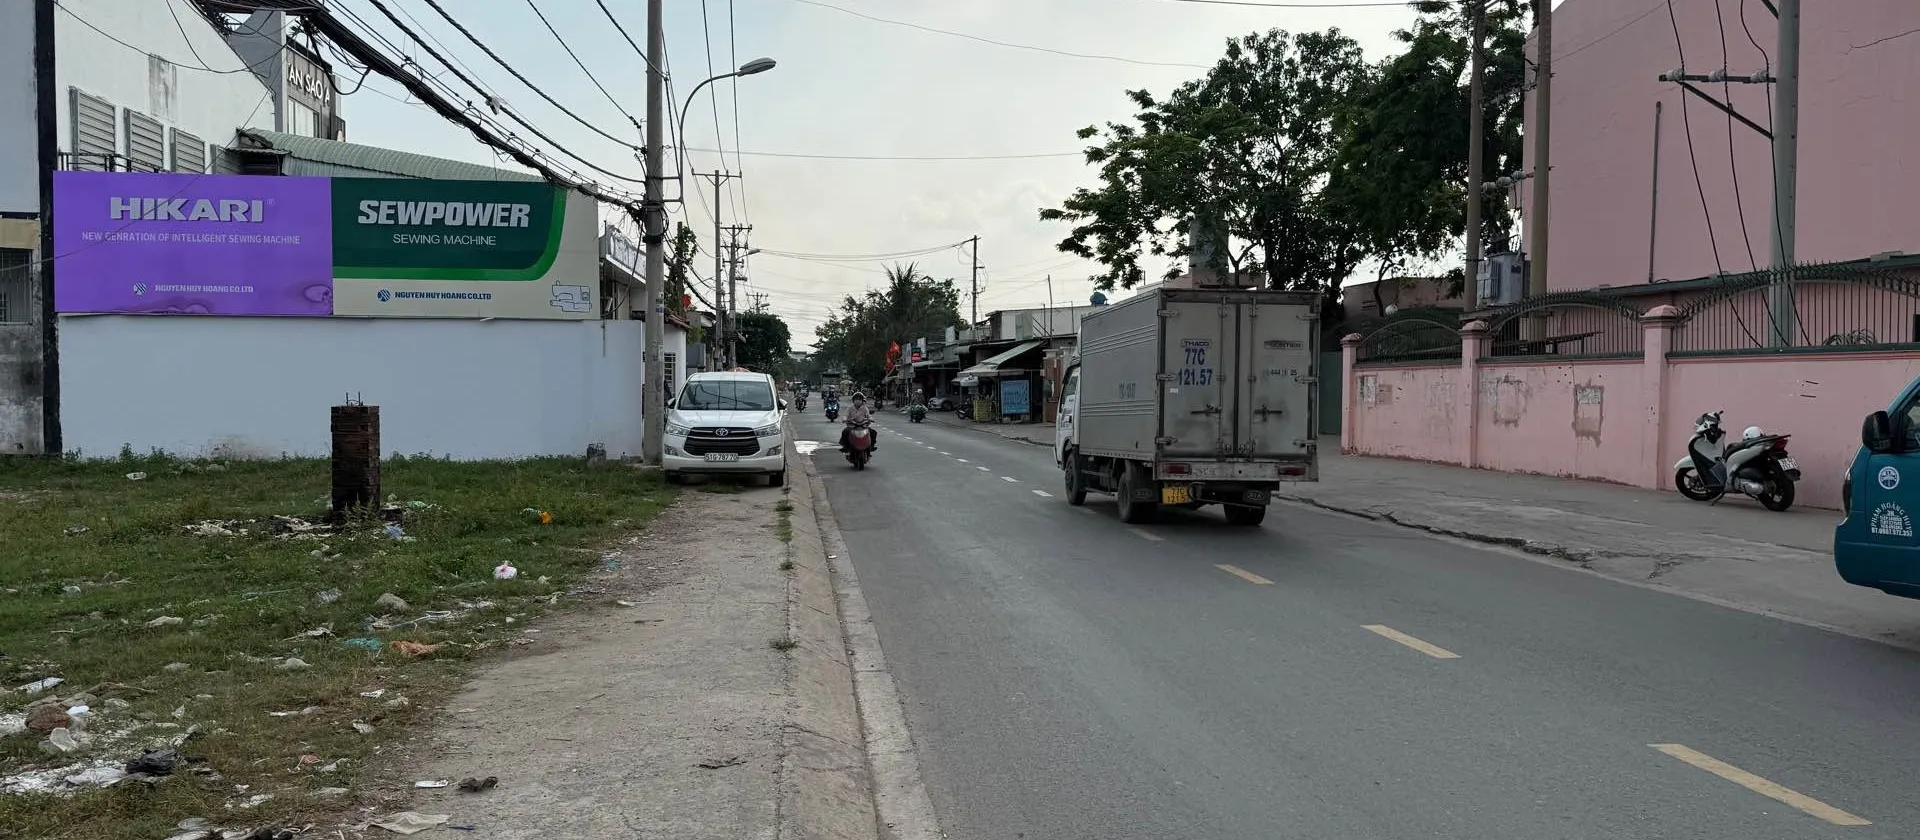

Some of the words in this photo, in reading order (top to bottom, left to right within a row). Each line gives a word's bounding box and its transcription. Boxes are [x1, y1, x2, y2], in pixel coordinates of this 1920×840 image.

[110, 196, 264, 223] HIKARI
[358, 200, 531, 228] SEWPOWER
[82, 231, 102, 241] NEW
[105, 232, 156, 242] GENRATION
[158, 233, 170, 242] OF
[172, 233, 227, 243] INTELLIGENT
[229, 234, 262, 244] SEWING
[263, 235, 301, 245] MACHINE
[393, 233, 441, 245] SEWING
[443, 235, 497, 246] MACHINE
[155, 284, 186, 293] NGUYEN
[186, 284, 201, 293] HUY
[203, 285, 229, 293] HOANG
[395, 291, 425, 299] NGUYEN
[441, 292, 467, 300] HOANG
[1184, 347, 1206, 366] 77C
[1178, 368, 1213, 387] 121.57
